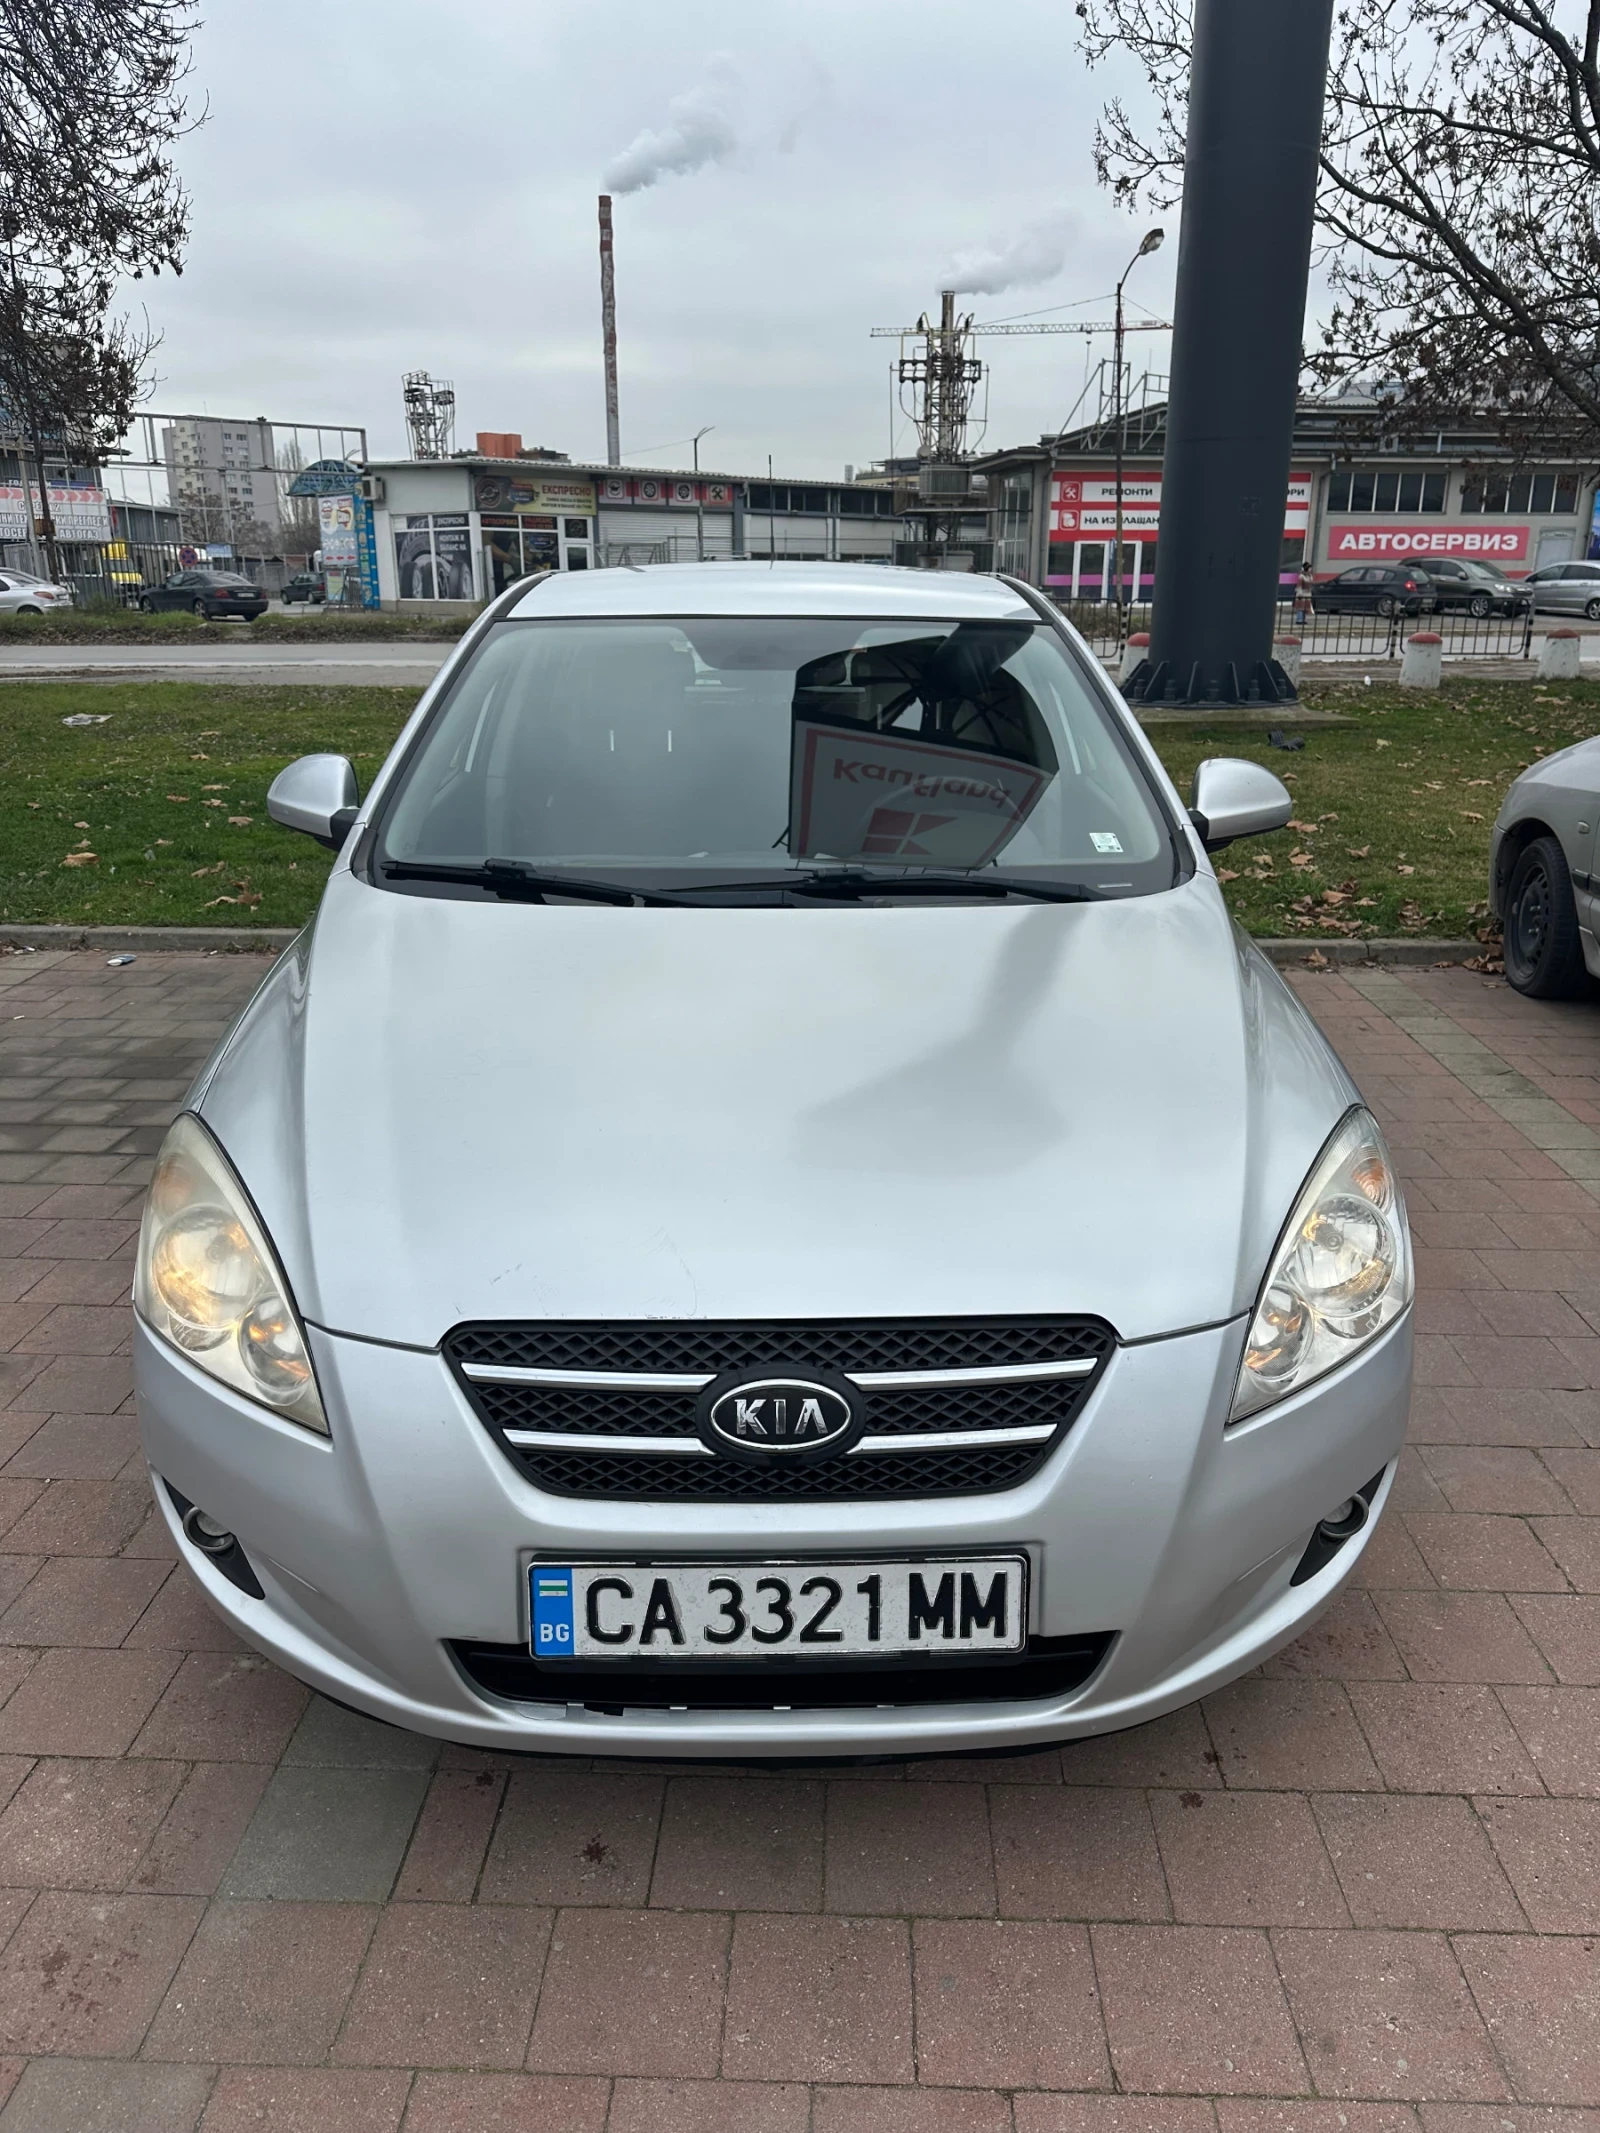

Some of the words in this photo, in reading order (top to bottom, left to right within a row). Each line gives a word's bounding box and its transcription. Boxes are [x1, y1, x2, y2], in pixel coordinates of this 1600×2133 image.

[541, 485, 592, 496] ЕКСПРЕСНО
[1101, 488, 1153, 496] РЕОНТИ
[1084, 516, 1099, 524] НА
[1101, 516, 1160, 525] ИЗЛАЩАН
[59, 529, 99, 539] АВТОГАЗ
[1339, 533, 1518, 550] АВТОСЕРВИЗ
[734, 1398, 829, 1435] KIA
[539, 1623, 570, 1643] BG
[585, 1575, 687, 1646] CA
[703, 1572, 882, 1644] 3321
[907, 1570, 1008, 1641] MM
